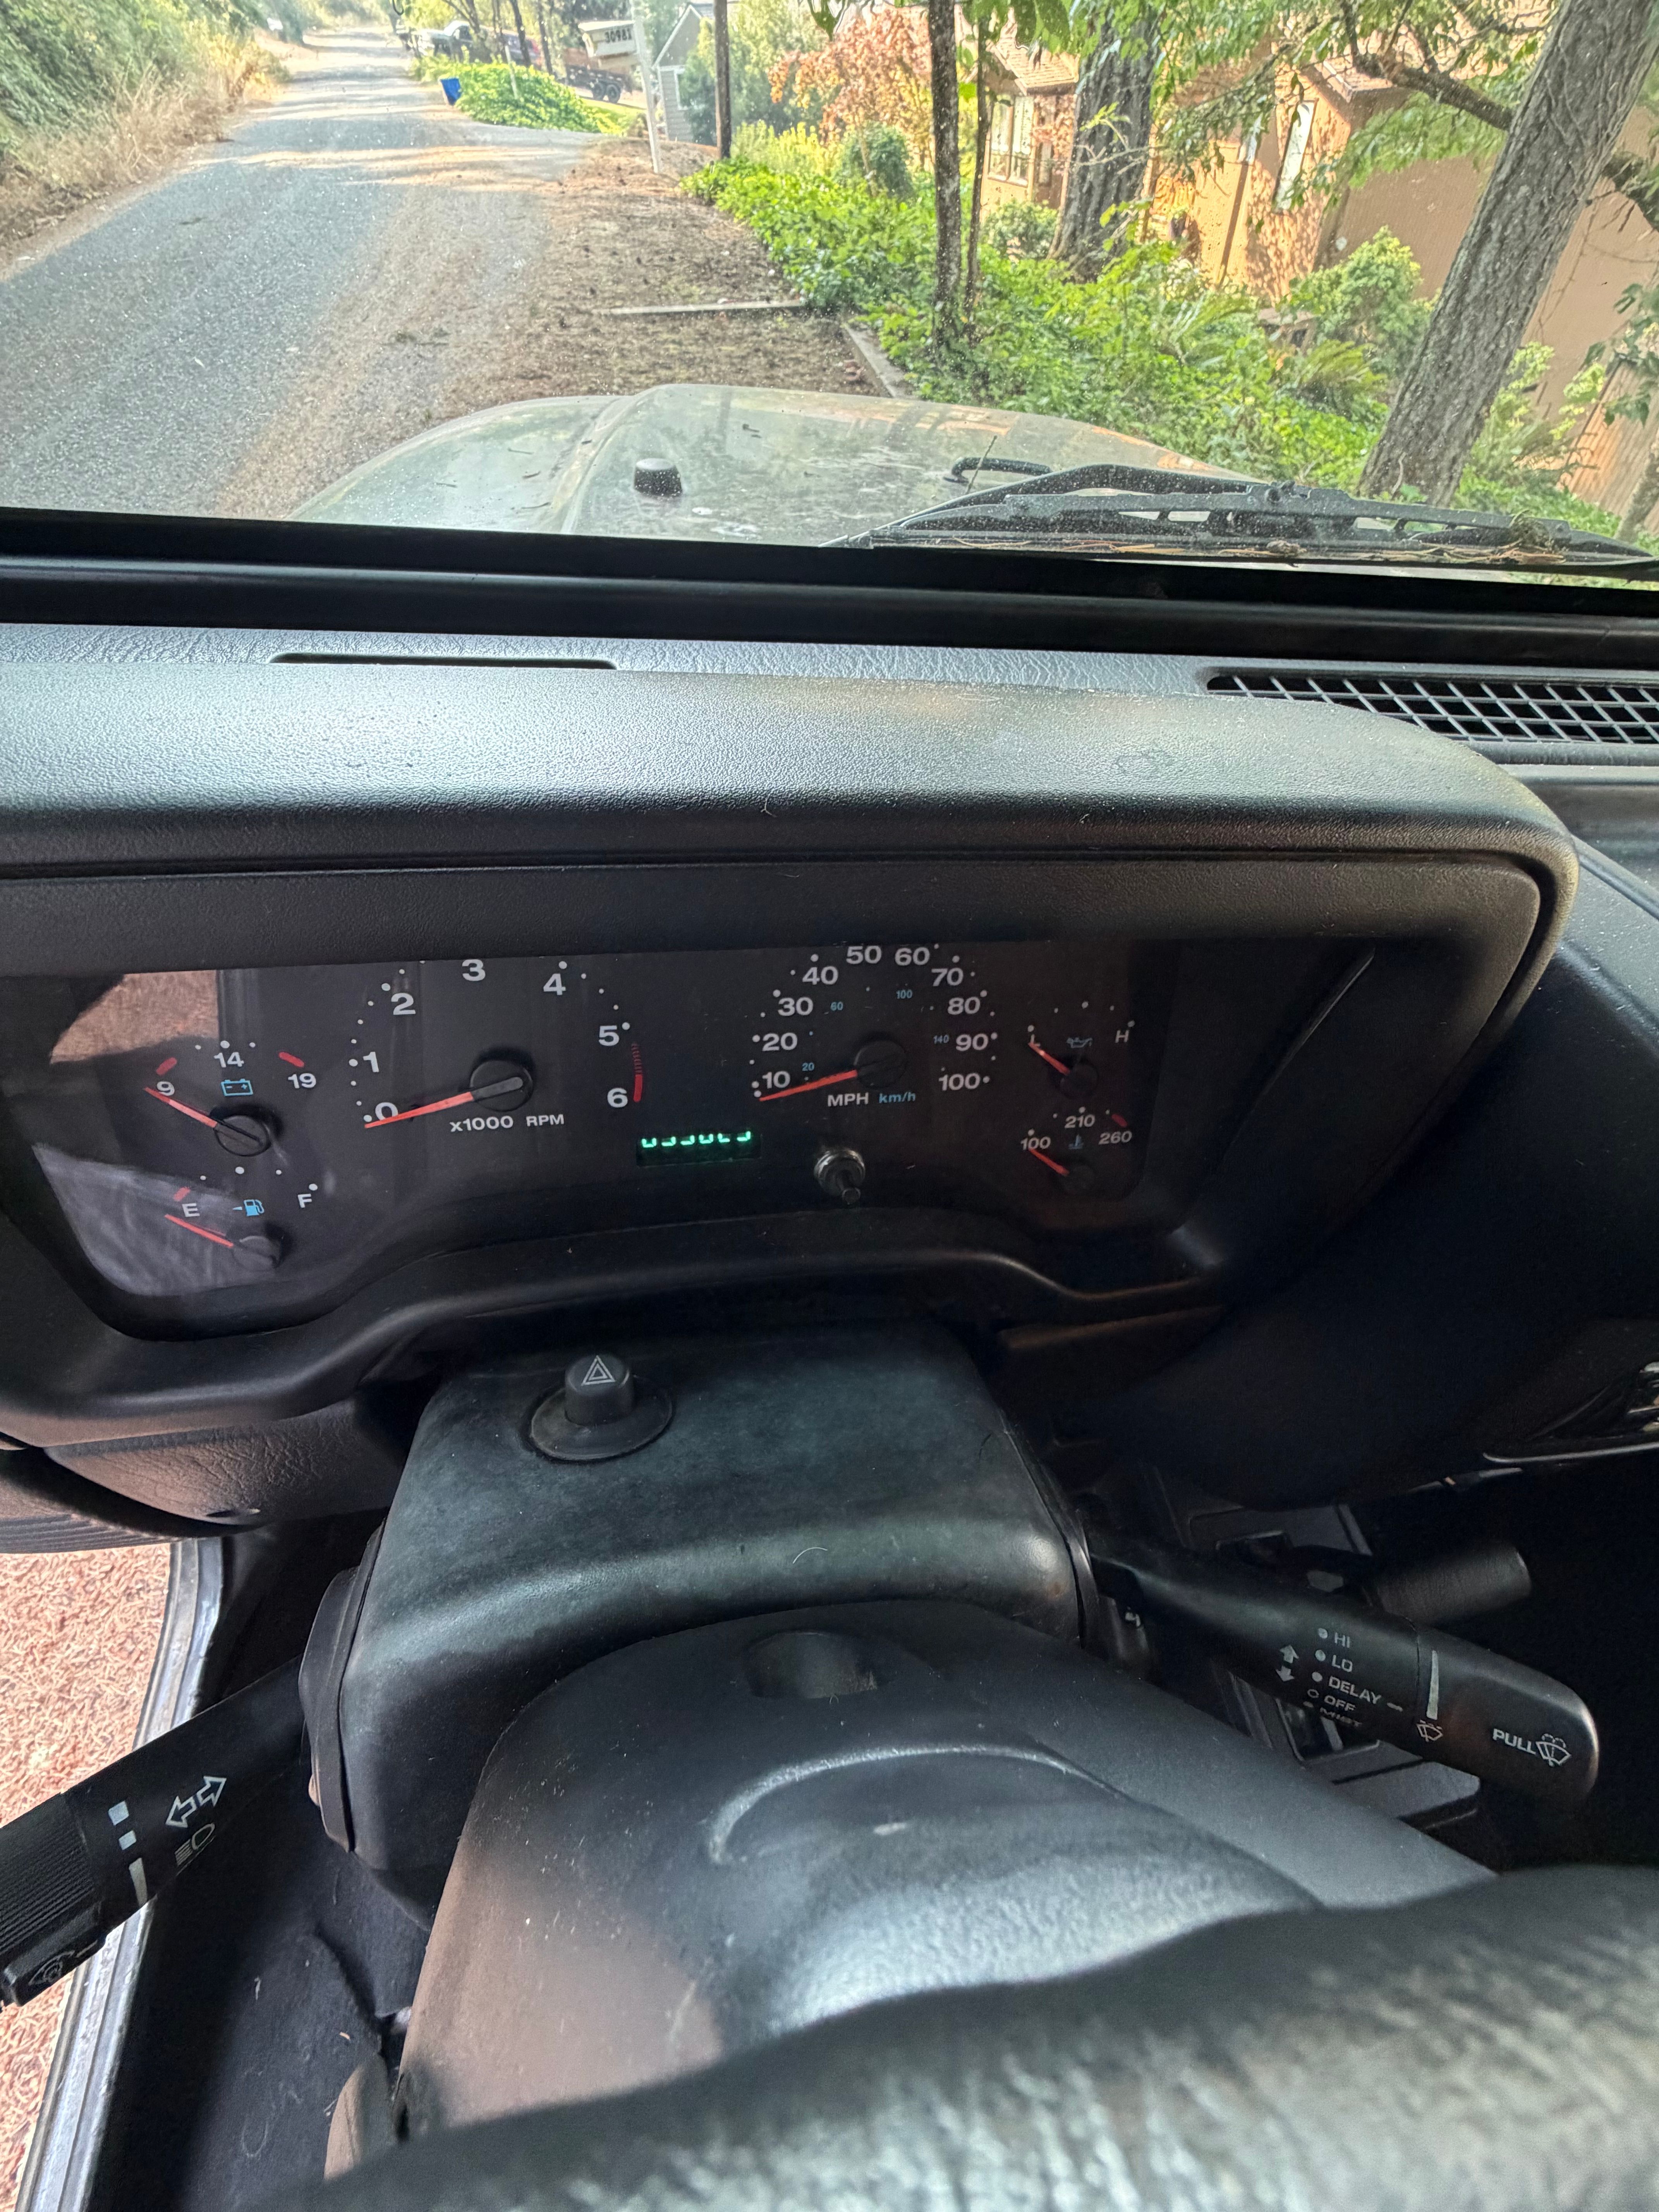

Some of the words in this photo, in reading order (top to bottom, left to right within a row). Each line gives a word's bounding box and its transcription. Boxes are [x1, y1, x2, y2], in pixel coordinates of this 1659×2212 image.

[846, 945, 882, 964] 50
[894, 947, 930, 965] 60
[462, 959, 486, 981] 3
[802, 966, 839, 985] 40
[931, 968, 963, 986] 70
[543, 973, 566, 996] 4
[896, 989, 913, 999] 100
[390, 993, 416, 1015] 2
[778, 997, 813, 1016] 30
[830, 1002, 843, 1010] 60
[947, 997, 980, 1015] 80
[598, 1025, 620, 1046] 5
[762, 1033, 798, 1051] 20
[933, 1035, 949, 1044] 140
[955, 1034, 988, 1051] 90
[1115, 1030, 1129, 1043] H
[214, 1052, 244, 1068] 14
[363, 1051, 380, 1073] 1
[802, 1063, 814, 1071] 20
[156, 1081, 175, 1096] 9
[288, 1073, 317, 1089] 19
[762, 1071, 790, 1089] 10
[938, 1073, 980, 1091] 100
[607, 1088, 628, 1108] 6
[827, 1092, 869, 1107] MPH
[879, 1092, 916, 1104] km/h
[375, 1102, 398, 1122] 0
[526, 1114, 565, 1127] RPM
[1065, 1115, 1095, 1128] 210
[1020, 1136, 1051, 1150] 100
[1098, 1130, 1132, 1145] 260
[182, 1203, 200, 1217] E
[298, 1194, 313, 1208] F
[1334, 1632, 1350, 1648] HI
[1331, 1654, 1353, 1672] LO
[1328, 1675, 1382, 1704] DELAY
[1324, 1695, 1356, 1711] OFF
[1492, 1728, 1536, 1755] PULL
